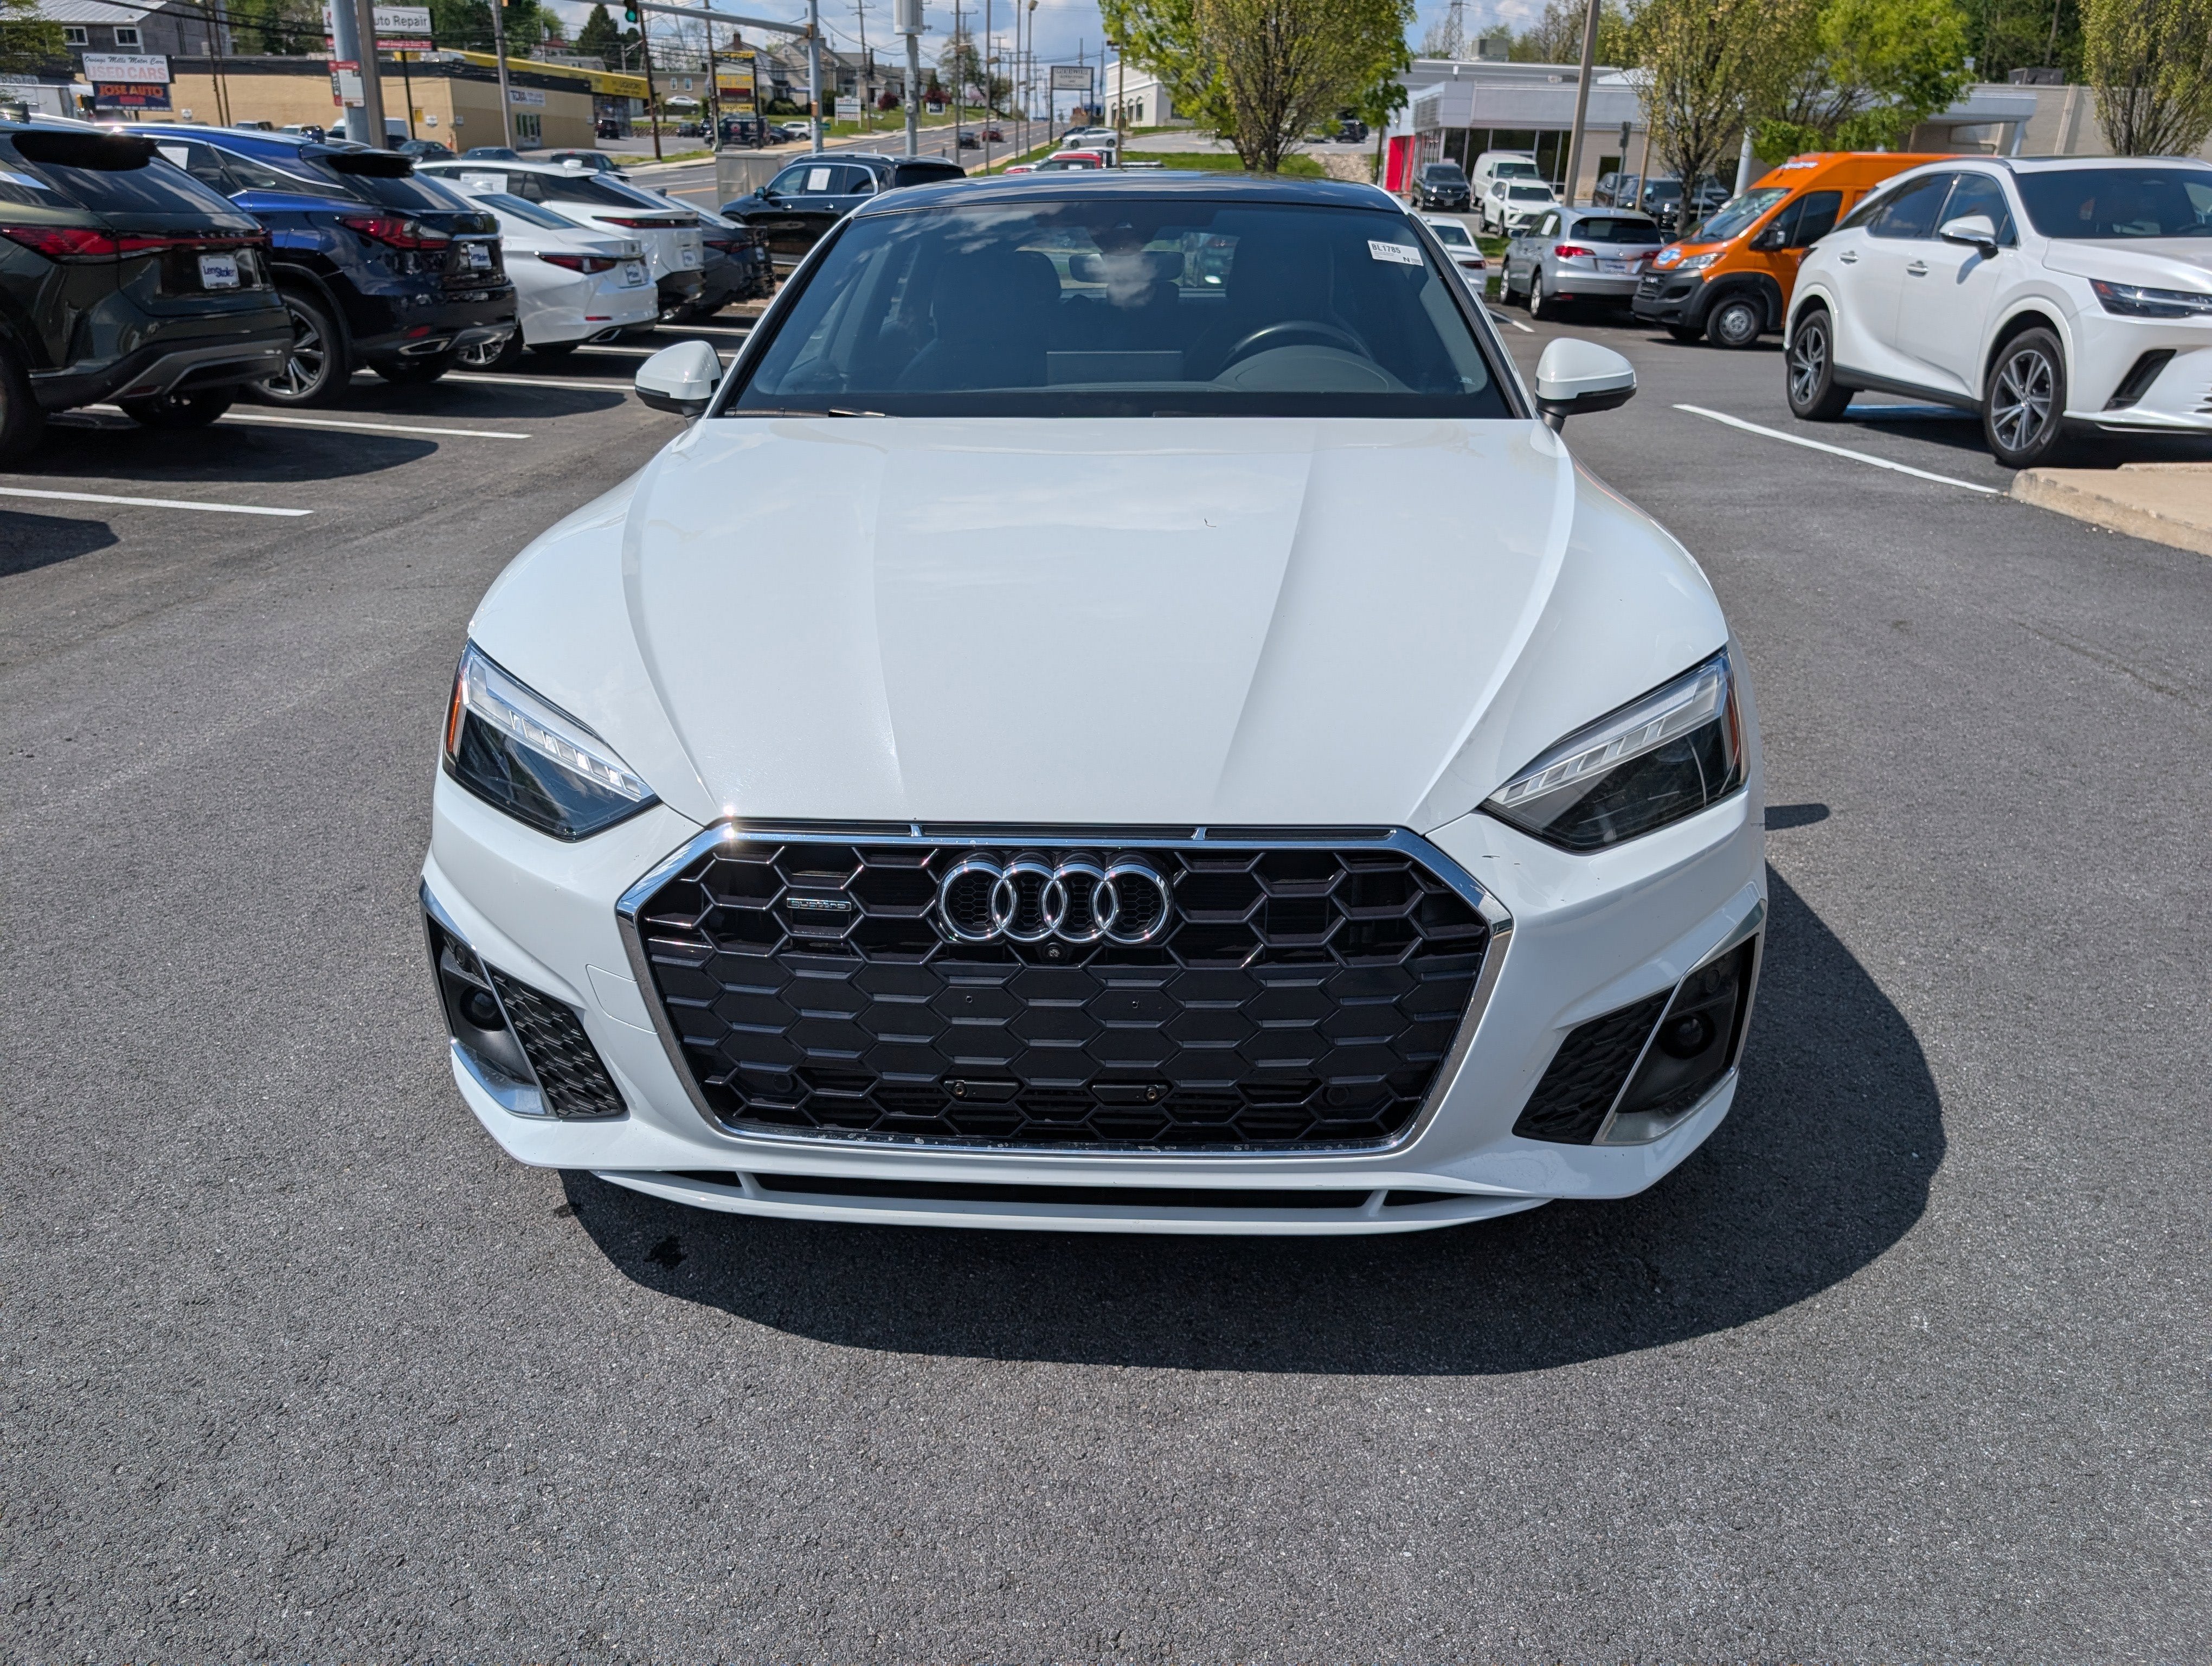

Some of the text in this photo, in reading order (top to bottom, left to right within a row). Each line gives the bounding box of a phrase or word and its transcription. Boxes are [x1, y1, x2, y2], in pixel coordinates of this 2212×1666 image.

[375, 15, 427, 28] uto Repair
[87, 66, 166, 80] USED CARS
[130, 86, 164, 98] AUTO
[1371, 244, 1401, 254] BL1785
[791, 900, 846, 909] quattro
